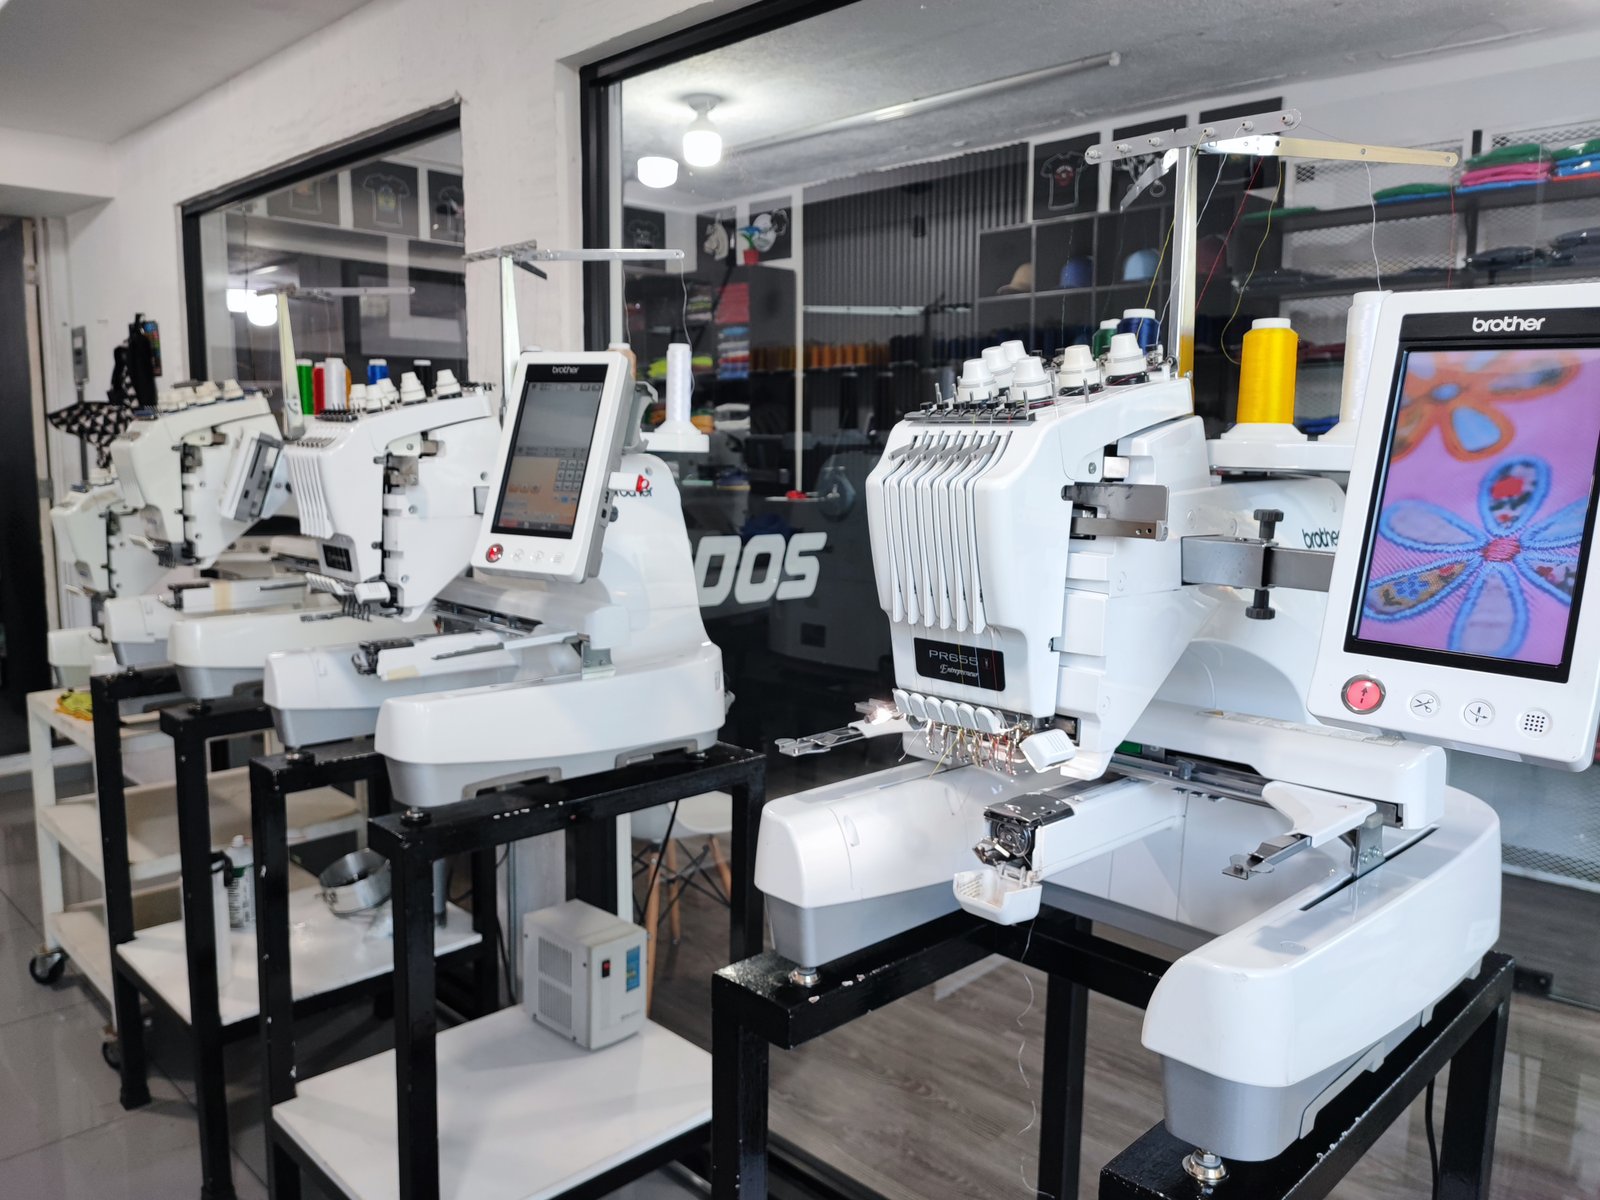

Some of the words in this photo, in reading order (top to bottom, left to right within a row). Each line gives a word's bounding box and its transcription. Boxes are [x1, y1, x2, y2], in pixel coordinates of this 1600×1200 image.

[1472, 316, 1546, 333] brother
[552, 365, 580, 375] brother
[1301, 527, 1340, 549] brothe
[690, 532, 828, 608] DOS
[928, 649, 979, 666] PR655
